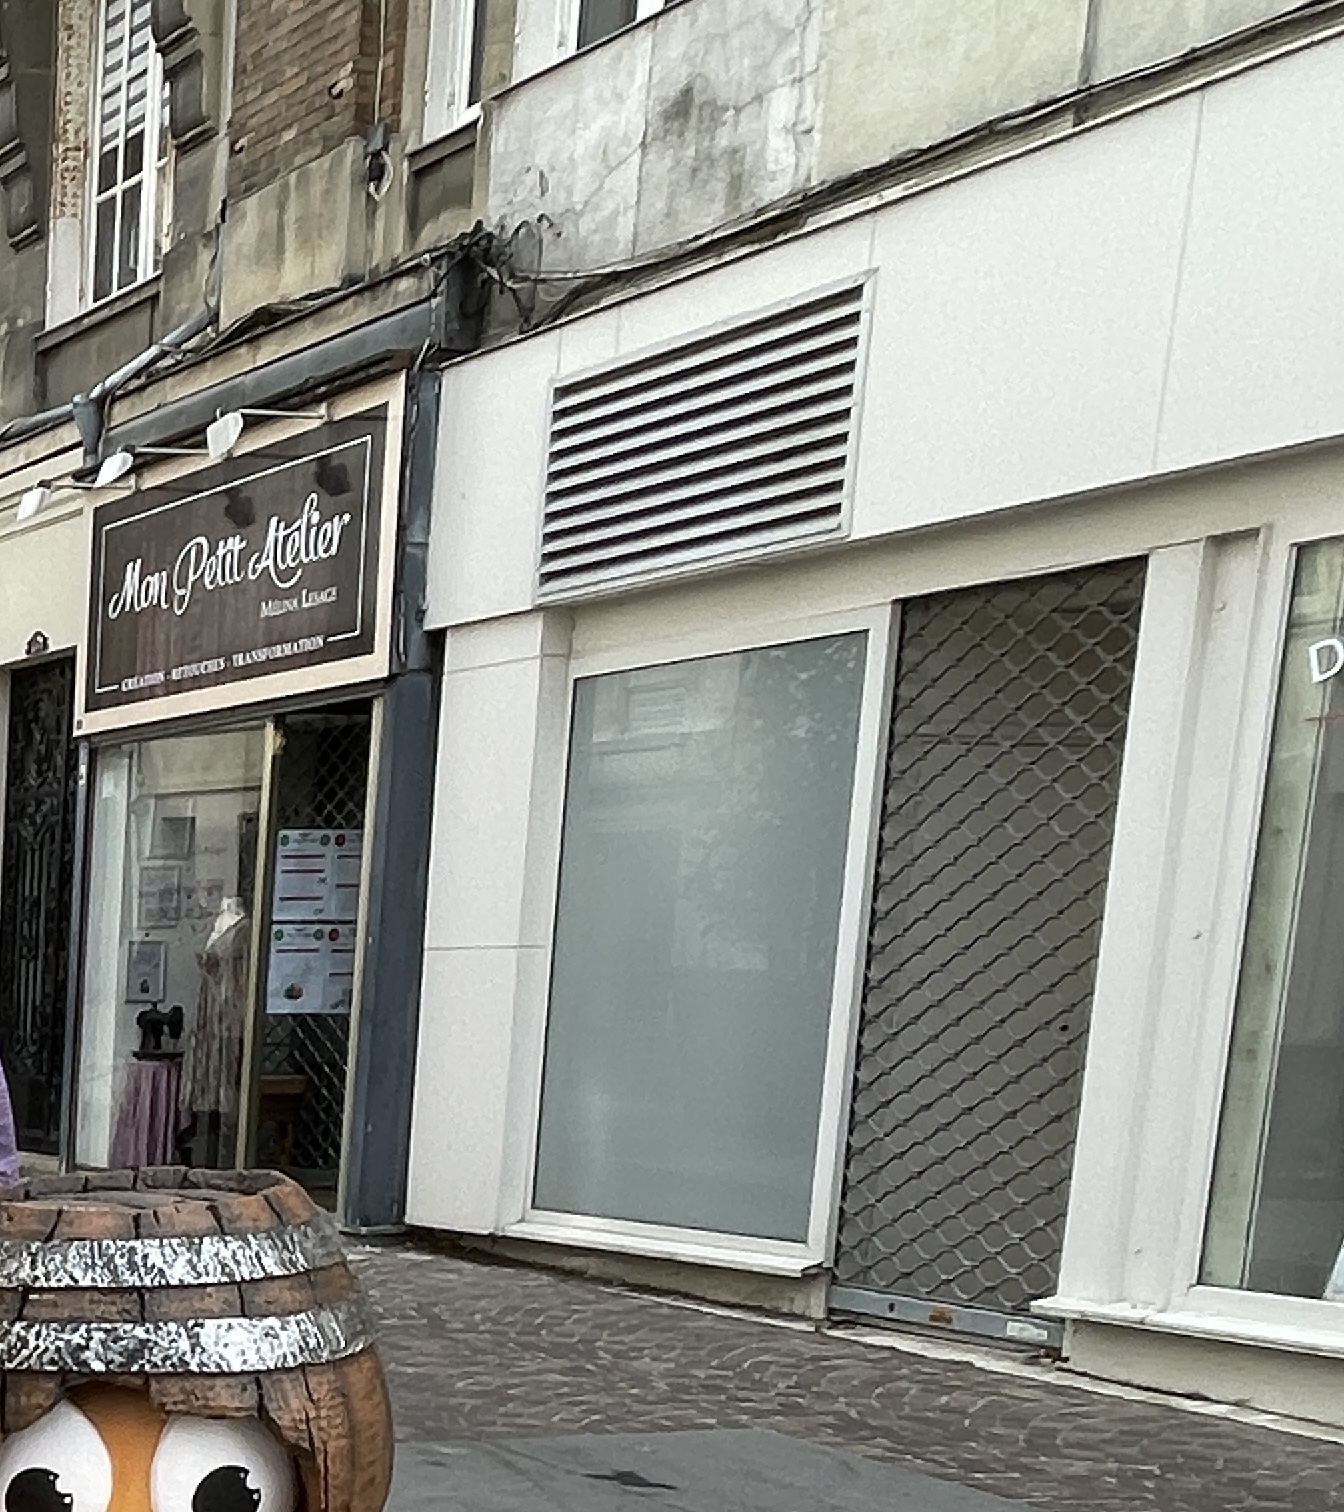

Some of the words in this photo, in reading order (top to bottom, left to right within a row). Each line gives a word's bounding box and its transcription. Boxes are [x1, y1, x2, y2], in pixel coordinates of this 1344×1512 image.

[108, 558, 170, 620] Mon
[172, 534, 247, 616] Petit
[248, 491, 352, 589] Atelier
